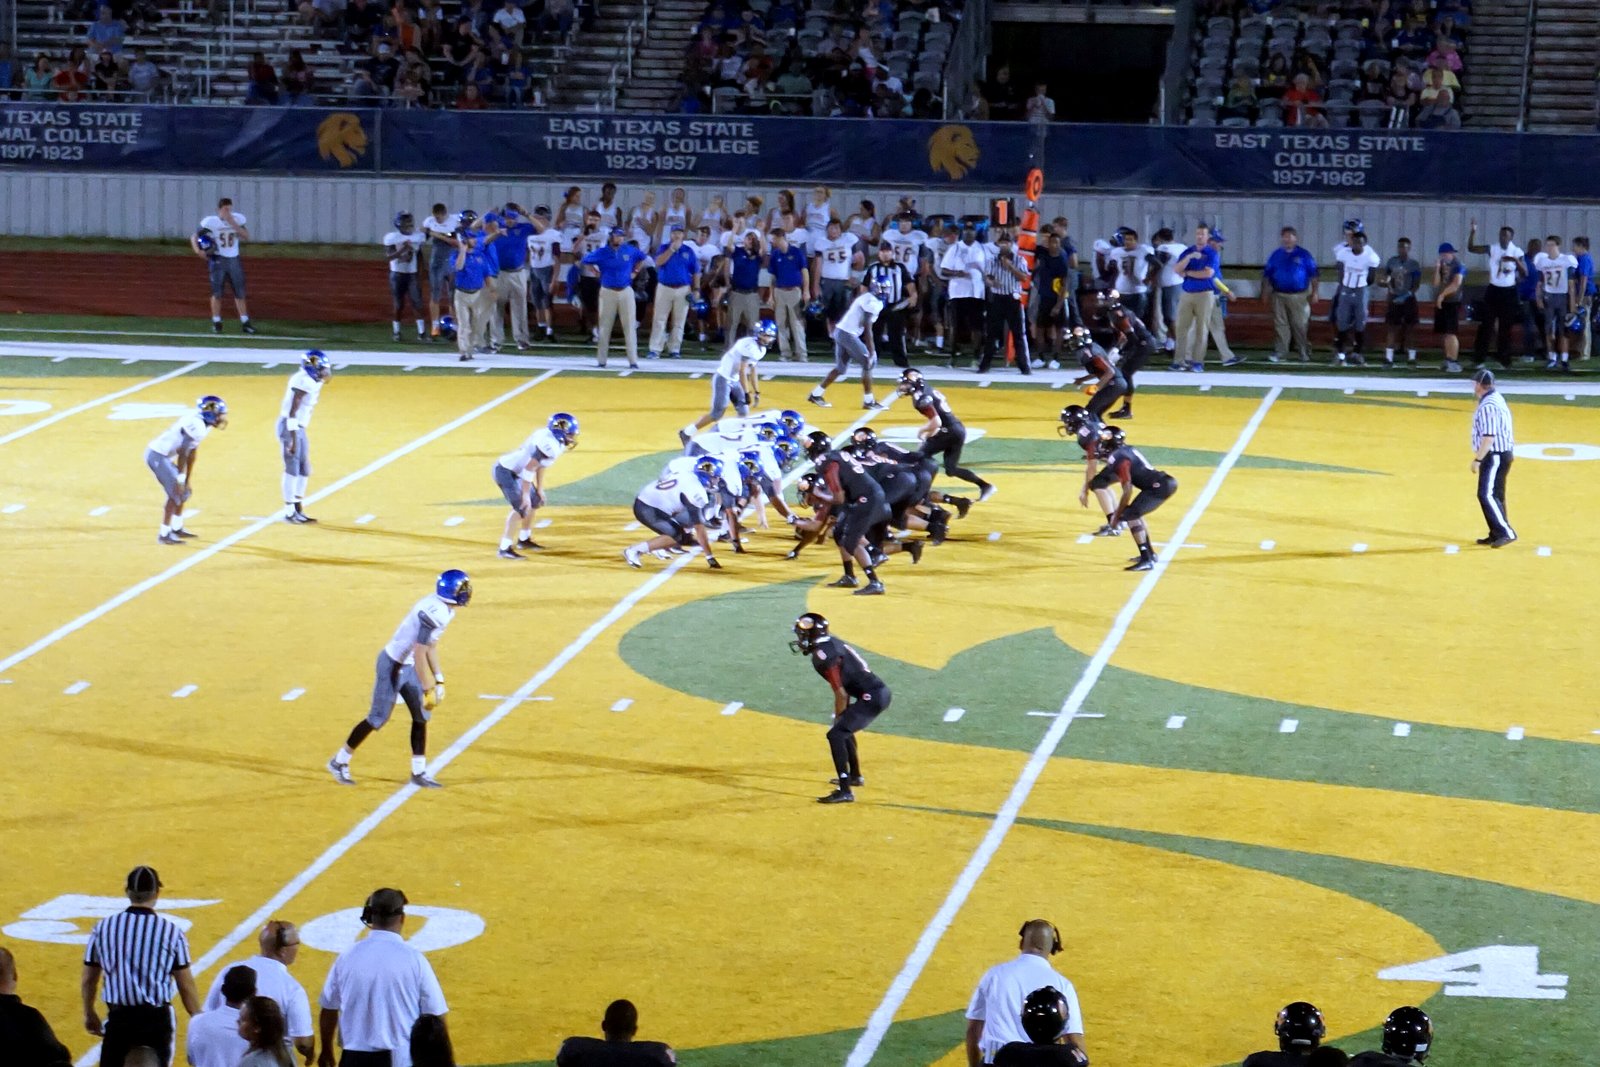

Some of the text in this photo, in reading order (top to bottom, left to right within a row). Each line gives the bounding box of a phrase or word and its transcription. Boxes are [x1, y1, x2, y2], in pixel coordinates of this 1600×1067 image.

[4, 110, 142, 127] TEXAS STATE
[44, 128, 138, 144] COLLEGE
[549, 118, 754, 137] EAST TEXAS STATE
[543, 136, 760, 154] TEACHERS COLLEGE
[1215, 134, 1425, 151] EAST TEXAS STATE
[0, 144, 84, 160] 1917-1923
[1274, 152, 1373, 168] COLLEGE
[605, 154, 697, 170] 1923-1957
[1273, 170, 1366, 186] 1957-1962
[995, 200, 1008, 225] 1
[1376, 944, 1570, 1000] 4
